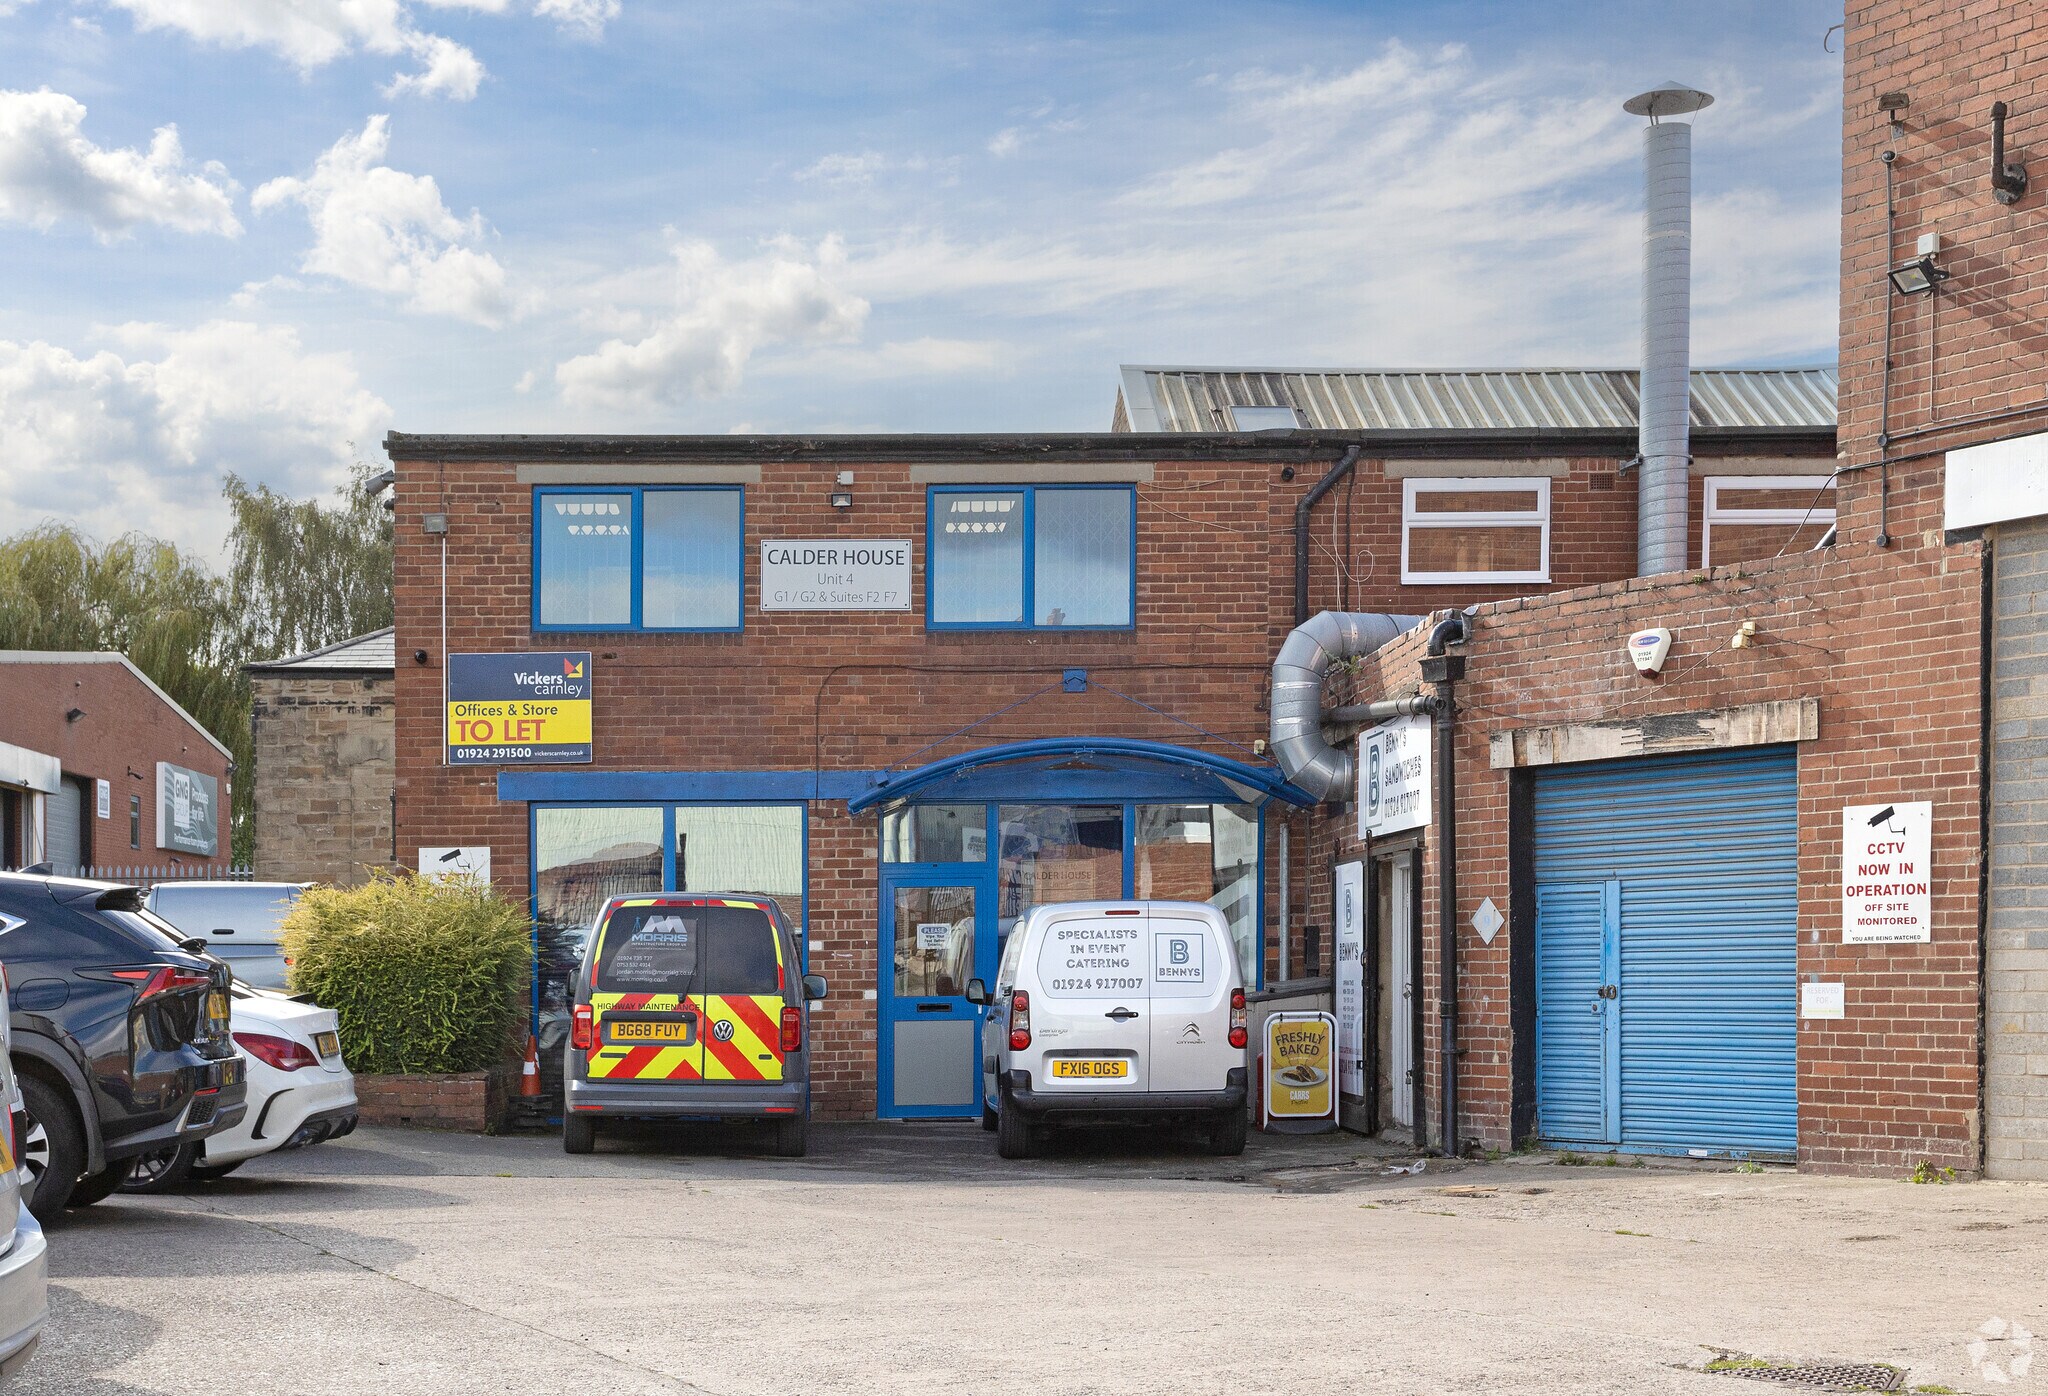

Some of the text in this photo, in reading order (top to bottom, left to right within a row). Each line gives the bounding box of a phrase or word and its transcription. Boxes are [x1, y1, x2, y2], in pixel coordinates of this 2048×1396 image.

[767, 549, 905, 566] CALDER HOUSE
[817, 573, 854, 585] Unit 4
[774, 591, 898, 604] G1 / G2 & Suites F2 F7
[513, 671, 563, 685] Vickers
[534, 681, 583, 698] carnley
[455, 703, 558, 717] Offices & Store
[455, 719, 546, 742] TO LET
[457, 748, 491, 759] 01924
[492, 747, 532, 758] 291500
[1867, 842, 1905, 855] CCTV
[1858, 863, 1914, 876] NOW IN
[1846, 883, 1927, 897] OPERATION
[1864, 903, 1909, 912] OFF SITE
[1857, 917, 1918, 926] MONITORED
[631, 933, 688, 942] MORRIS
[1057, 929, 1138, 940] SPECIALISTS
[1070, 943, 1126, 954] IN EVENT
[1169, 939, 1190, 965] B
[1066, 958, 1130, 969] CATERING
[1158, 967, 1201, 977] BENNYS
[1052, 977, 1143, 990] 01924 917007
[597, 1002, 701, 1012] HIGHWAY MAINTENANCE
[617, 1022, 682, 1038] BG68 FUY
[1275, 1031, 1325, 1046] FRESHLY
[1279, 1043, 1320, 1057] BAKED
[1060, 1062, 1120, 1075] FX16 OGS
[1289, 1090, 1310, 1100] CARRS
